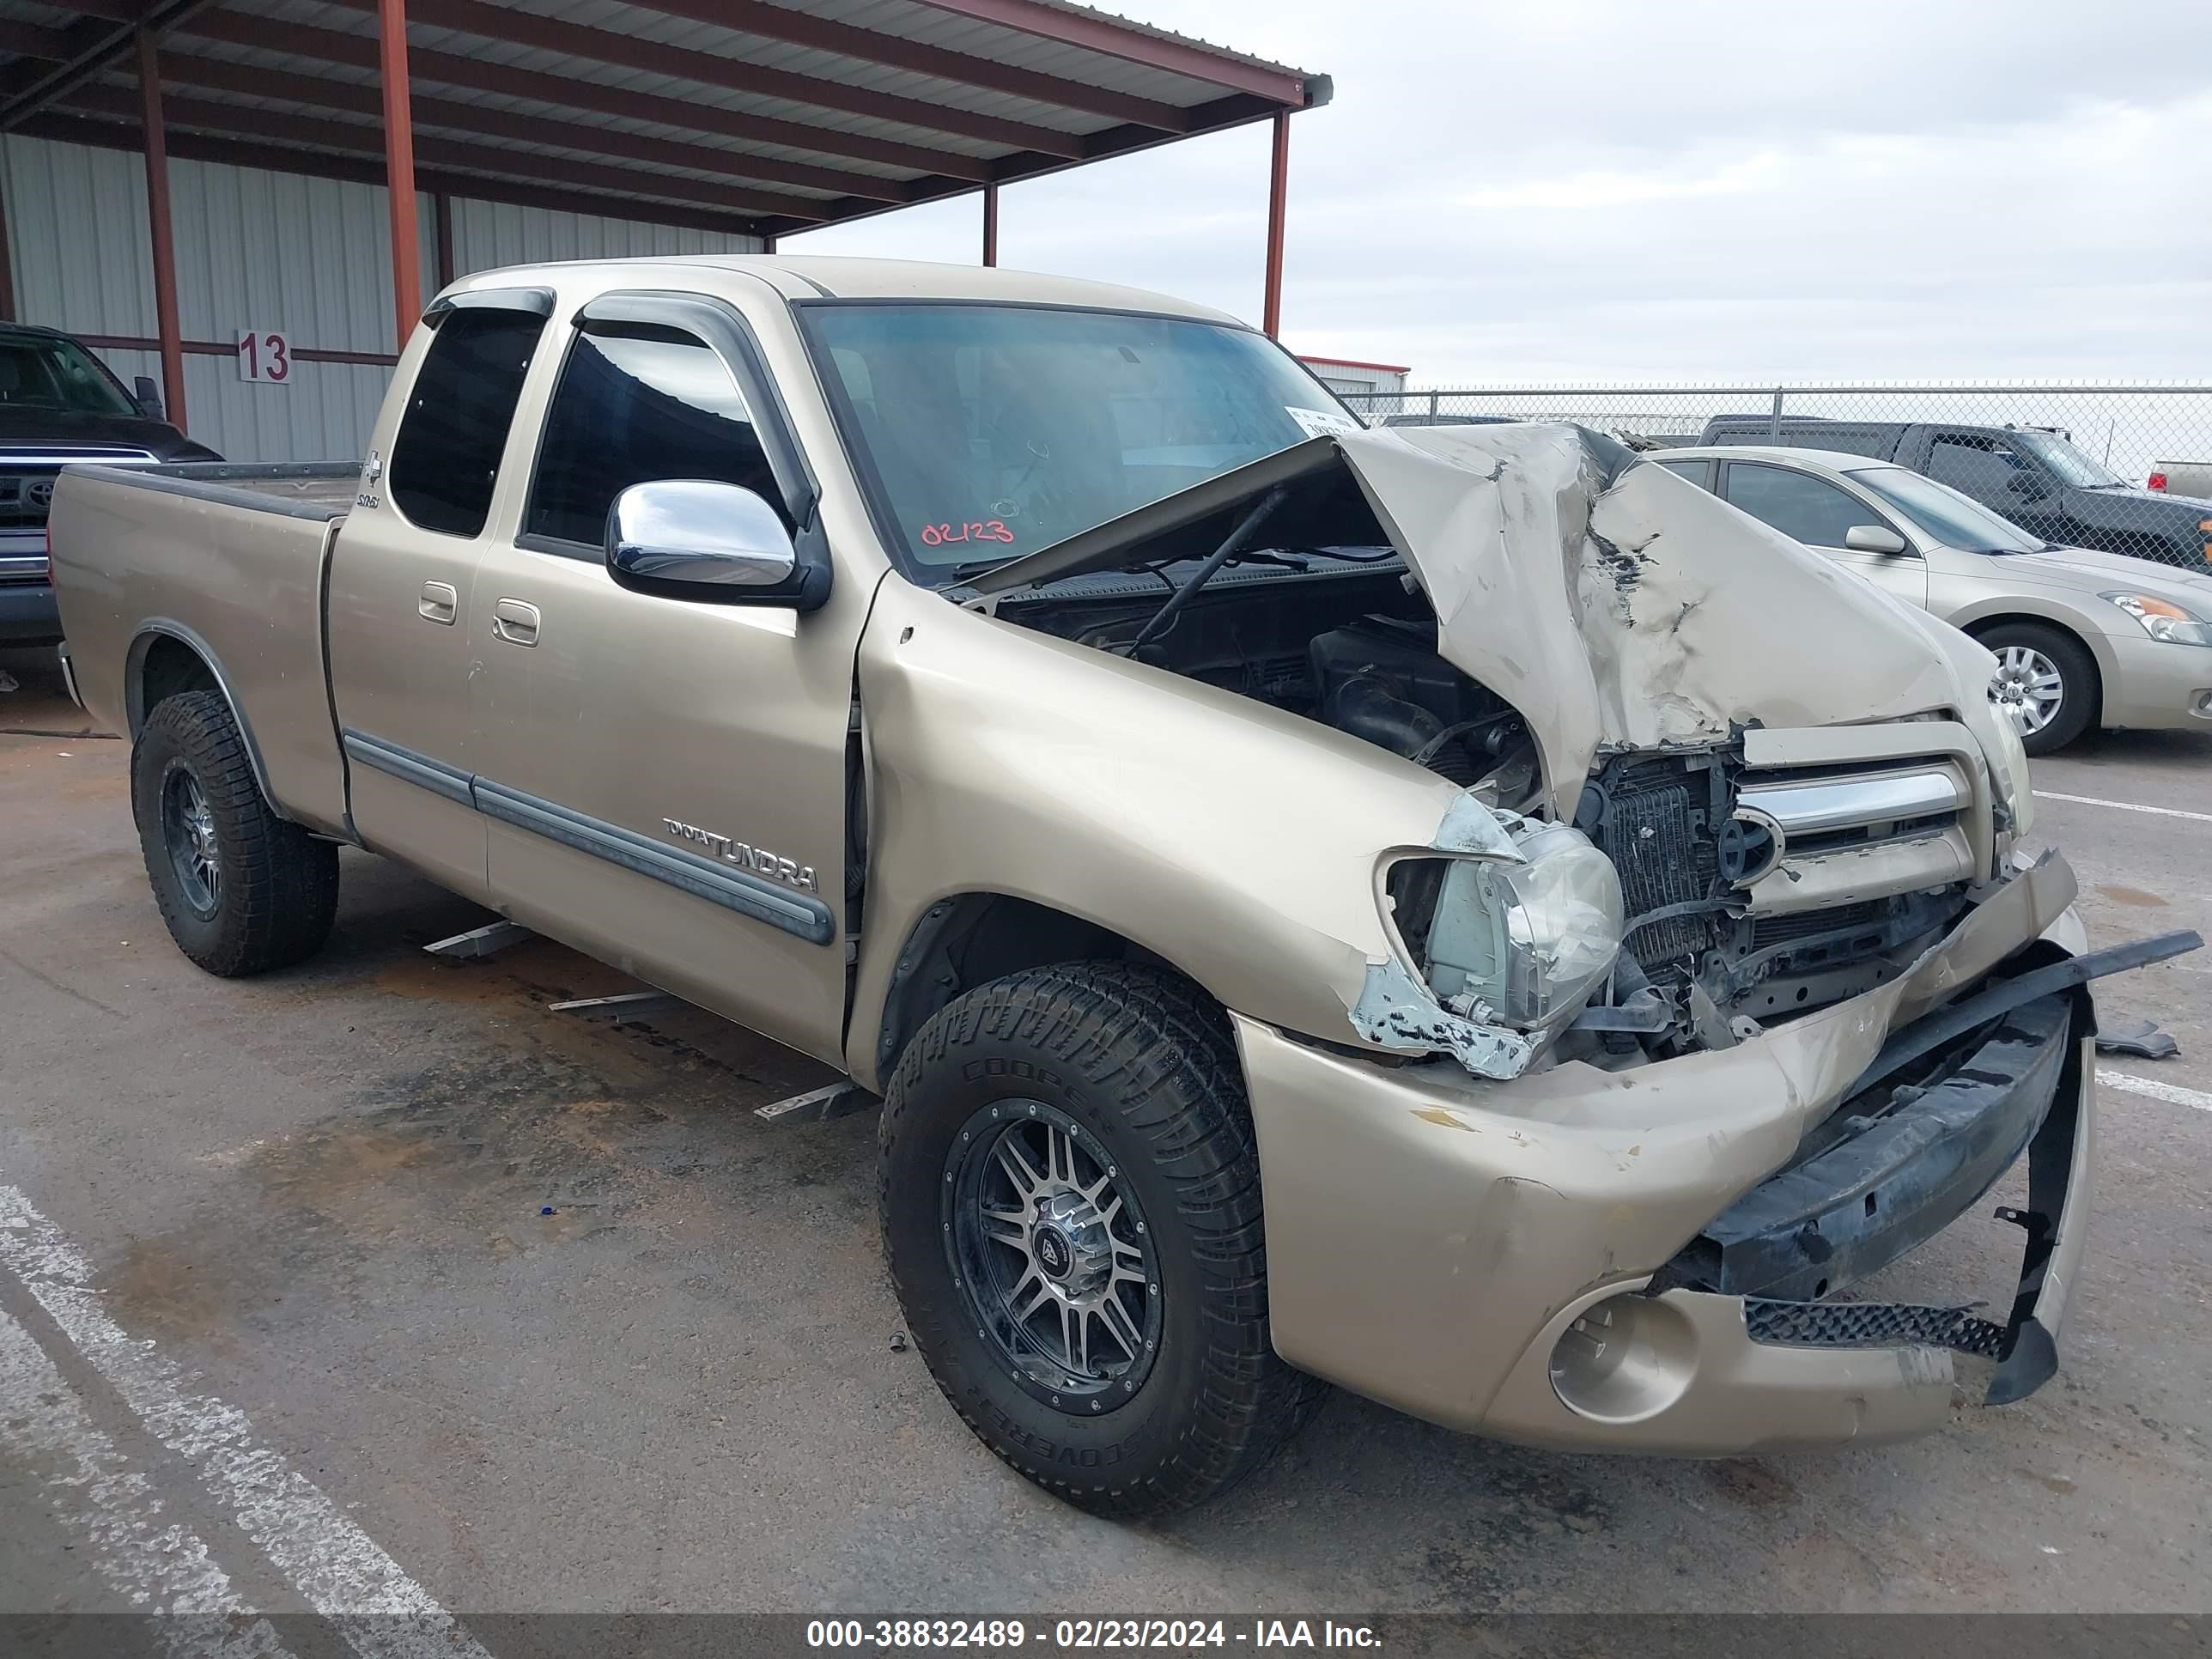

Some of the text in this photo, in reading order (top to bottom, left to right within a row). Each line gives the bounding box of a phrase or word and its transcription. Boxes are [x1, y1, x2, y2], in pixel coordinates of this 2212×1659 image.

[240, 332, 289, 380] 13
[662, 817, 818, 894] TOYOTA TUNDRA
[961, 1057, 1115, 1135] COOPER
